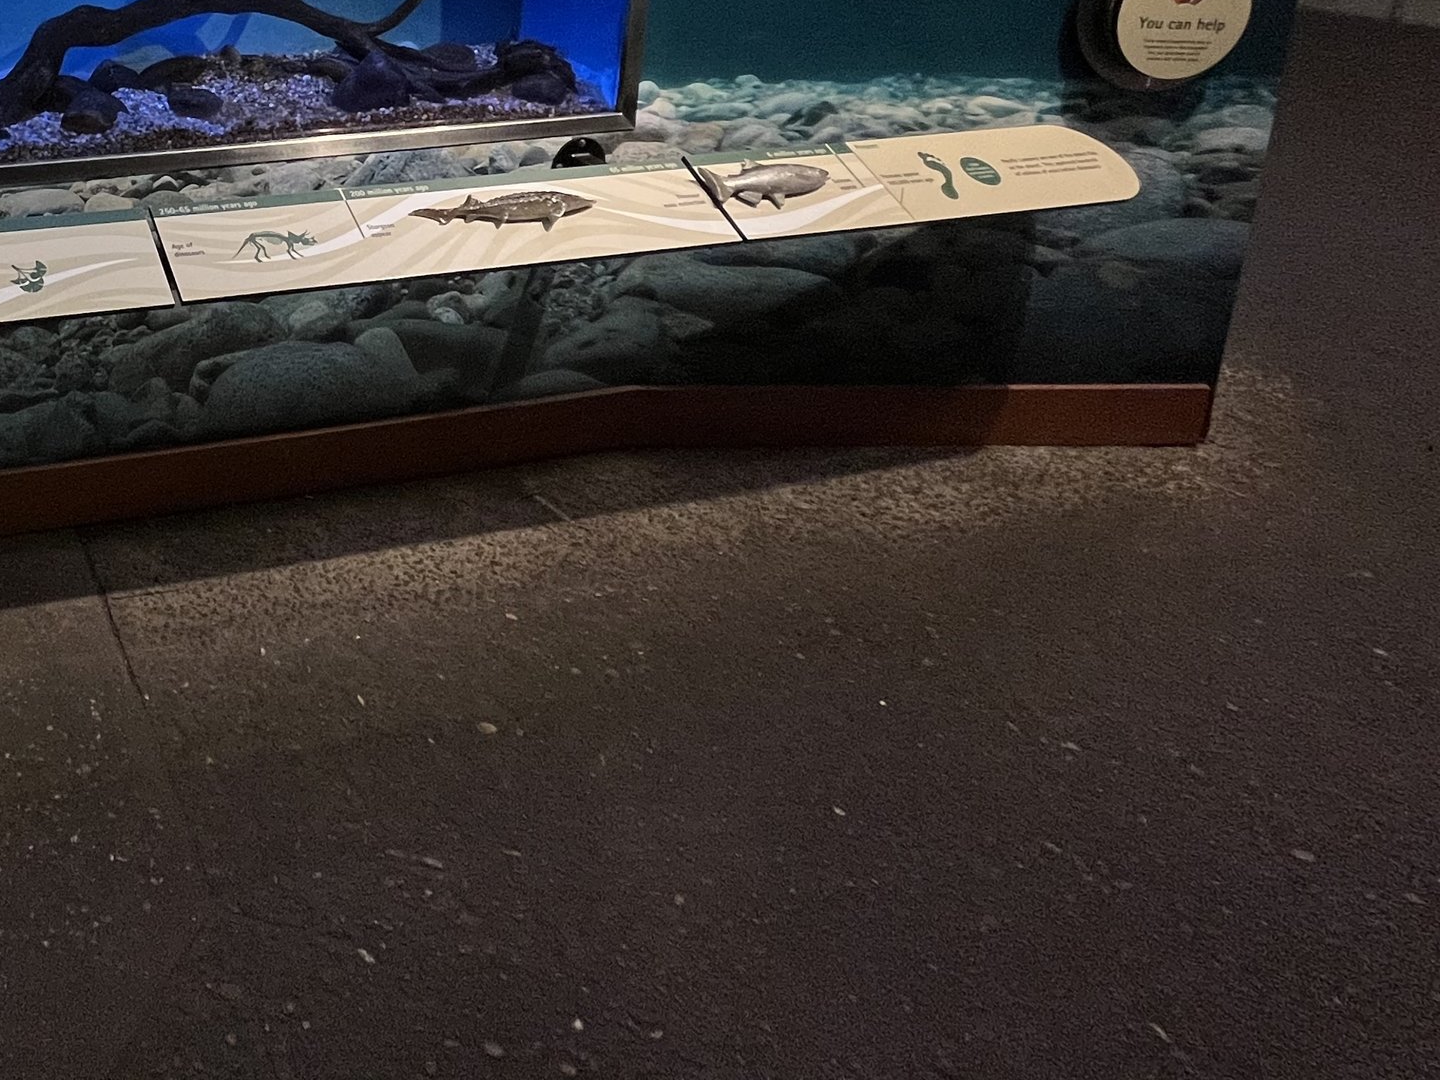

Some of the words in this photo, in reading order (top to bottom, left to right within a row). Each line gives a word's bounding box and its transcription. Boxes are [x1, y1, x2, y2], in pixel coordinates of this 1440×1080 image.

[1138, 16, 1164, 30] You
[1168, 19, 1192, 30] can
[1197, 18, 1227, 34] help
[192, 203, 220, 212] million
[221, 202, 242, 211] years
[243, 200, 258, 208] ago
